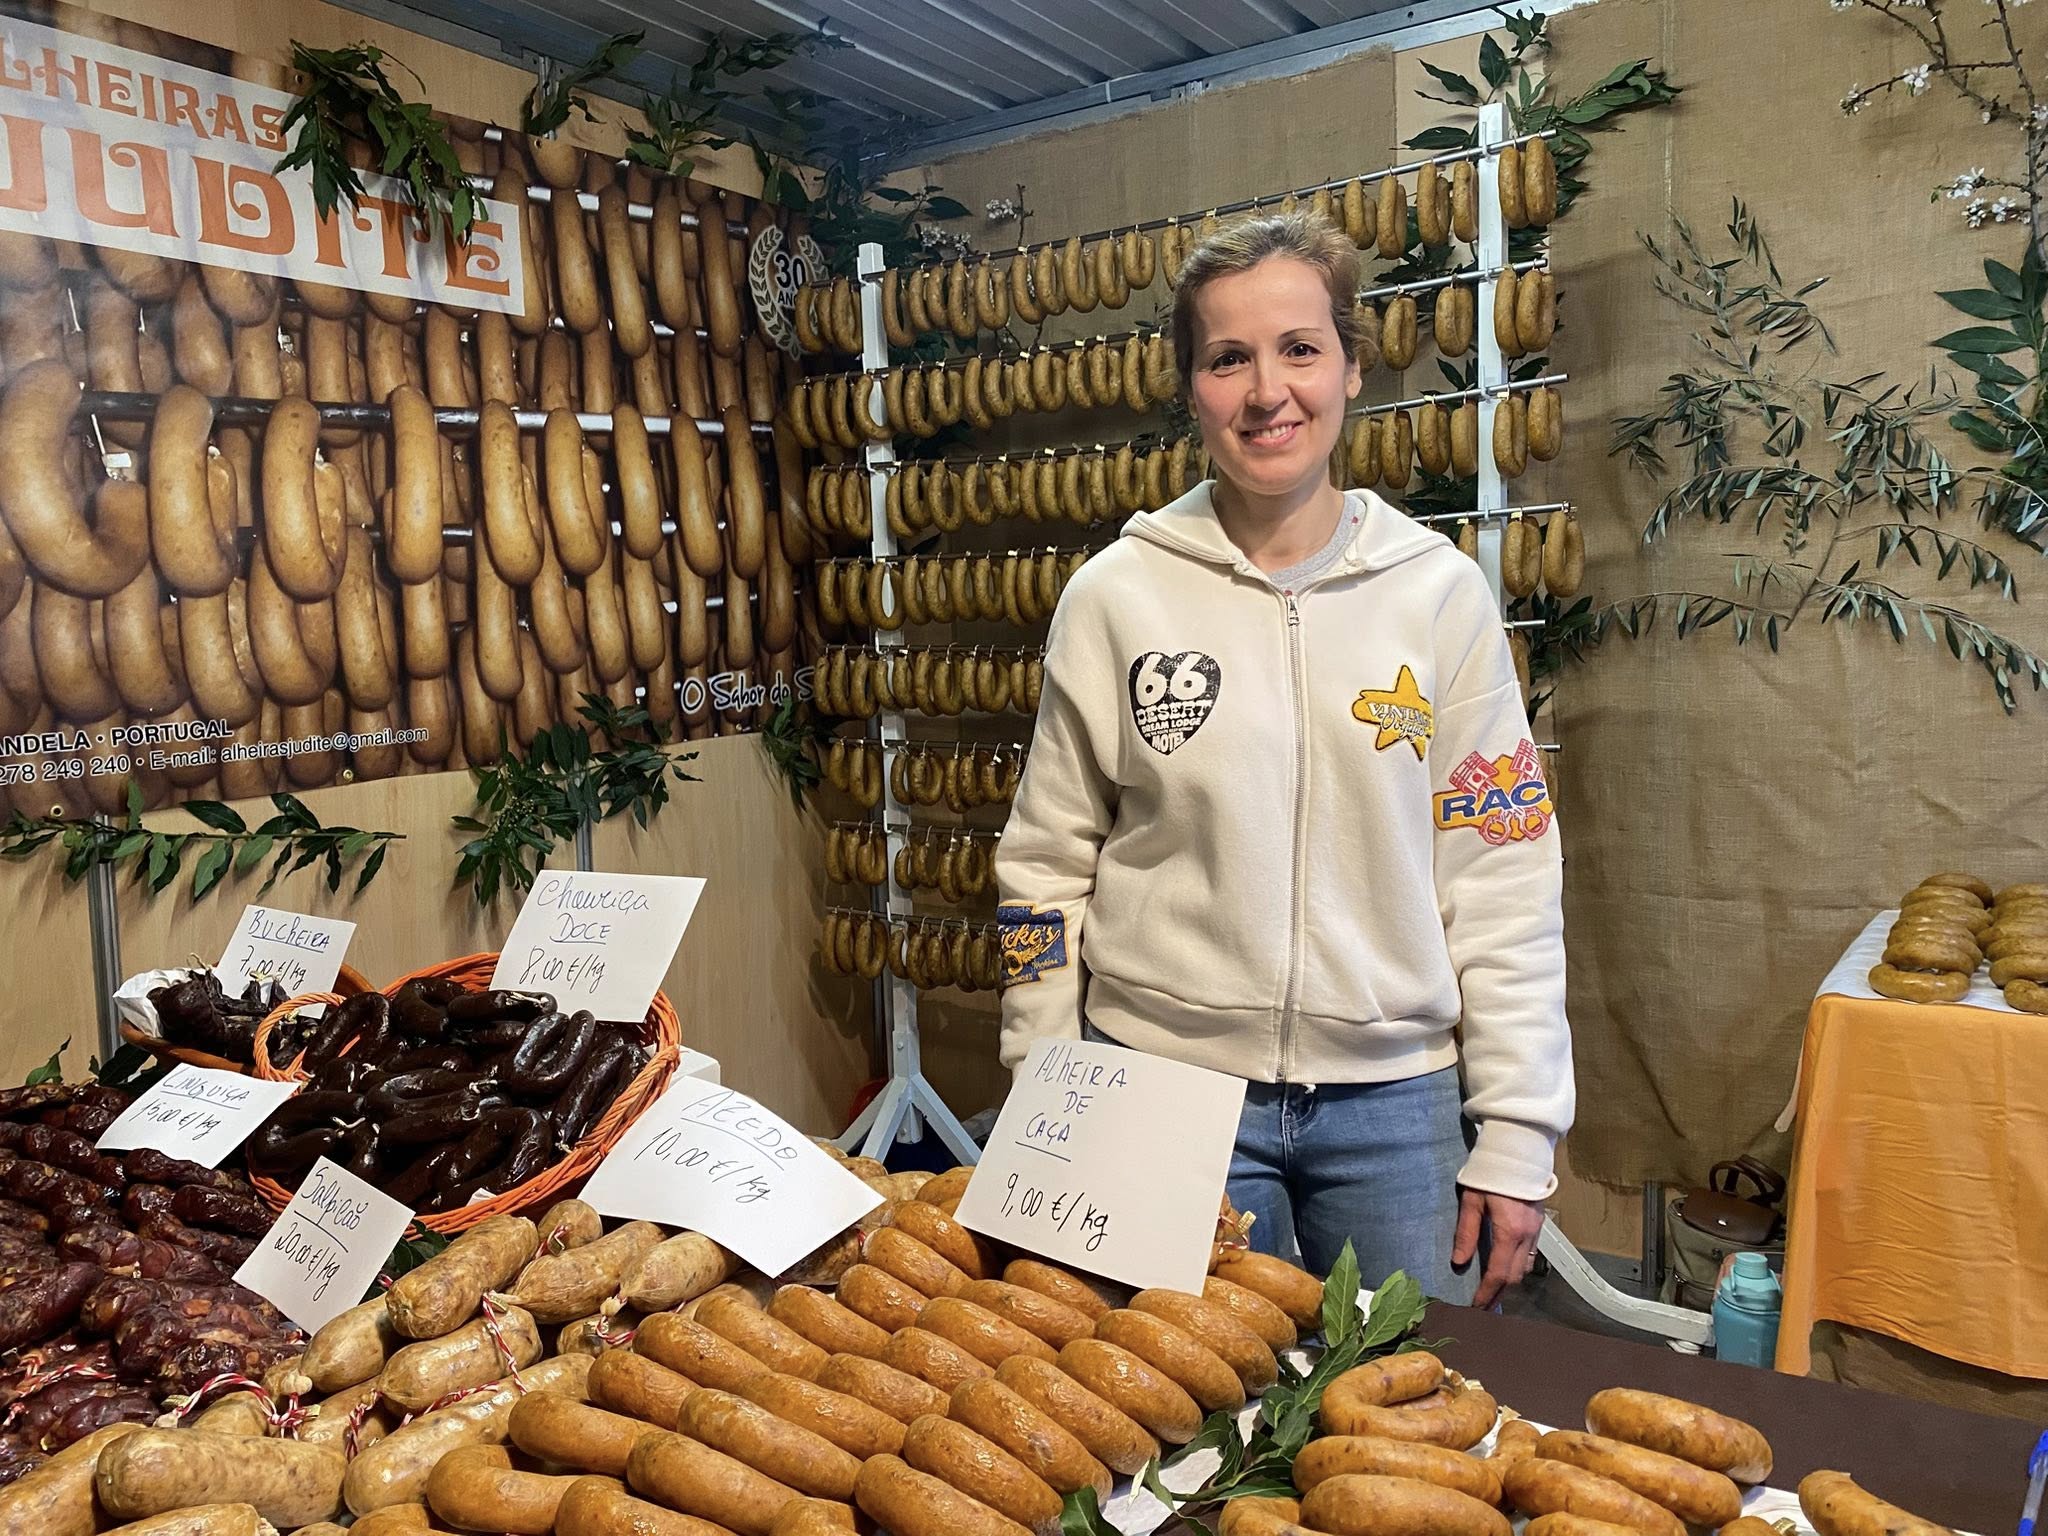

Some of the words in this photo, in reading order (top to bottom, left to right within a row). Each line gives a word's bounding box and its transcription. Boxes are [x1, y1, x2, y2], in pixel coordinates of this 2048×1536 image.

[0, 114, 510, 297] JUDITE
[774, 251, 807, 291] 30
[777, 289, 798, 309] AN
[681, 677, 705, 714] O
[709, 671, 766, 712] Sabor
[1136, 653, 1208, 707] 66
[1136, 699, 1213, 726] DESERT
[1141, 720, 1169, 733] DREAM
[1171, 718, 1202, 728] LODGE
[0, 731, 91, 757] NDELA
[111, 719, 234, 747] PORTUGAL
[42, 758, 84, 780] 249
[90, 755, 130, 776] 240
[150, 745, 217, 770] E-mail:
[220, 727, 429, 764] alheirasjudite@gmail.com
[1152, 731, 1186, 753] MOTEL
[553, 912, 611, 941] DOCE
[998, 923, 1060, 951] icke's
[1063, 1090, 1094, 1114] DE
[682, 1090, 798, 1160] AZEDO
[1025, 1112, 1072, 1146] CAÇA
[634, 1127, 709, 1167] 10,00
[1001, 1173, 1043, 1217] 9,00
